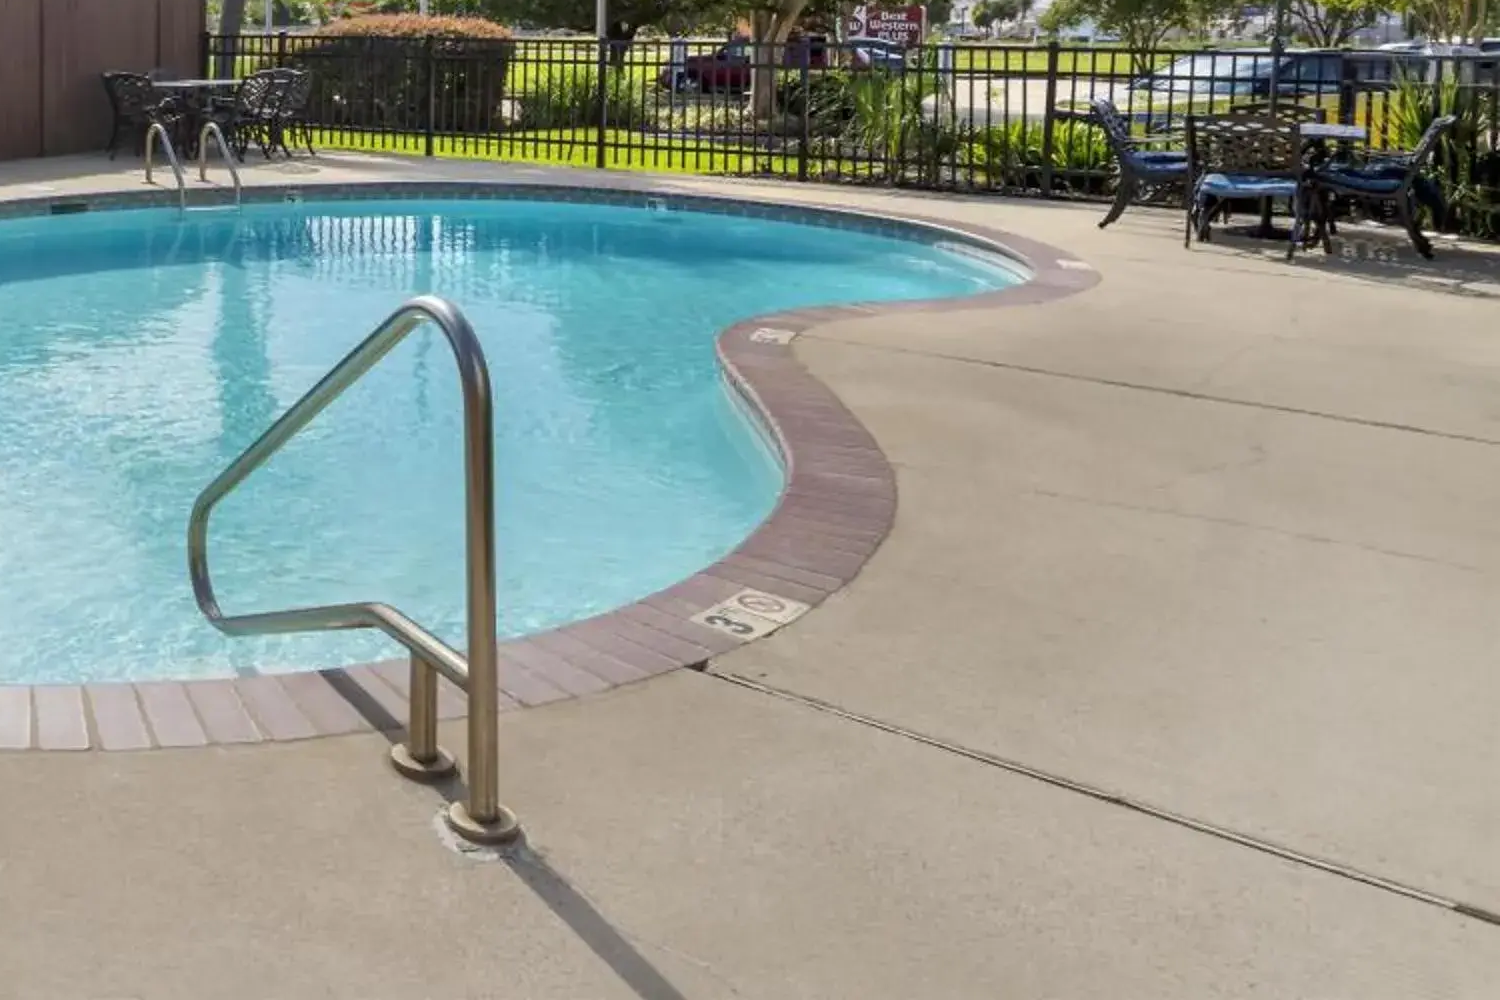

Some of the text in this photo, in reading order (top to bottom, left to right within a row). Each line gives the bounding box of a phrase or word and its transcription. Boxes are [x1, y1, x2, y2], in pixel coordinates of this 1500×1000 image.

[881, 11, 908, 21] Best
[869, 20, 918, 31] Western
[704, 615, 754, 635] 3
